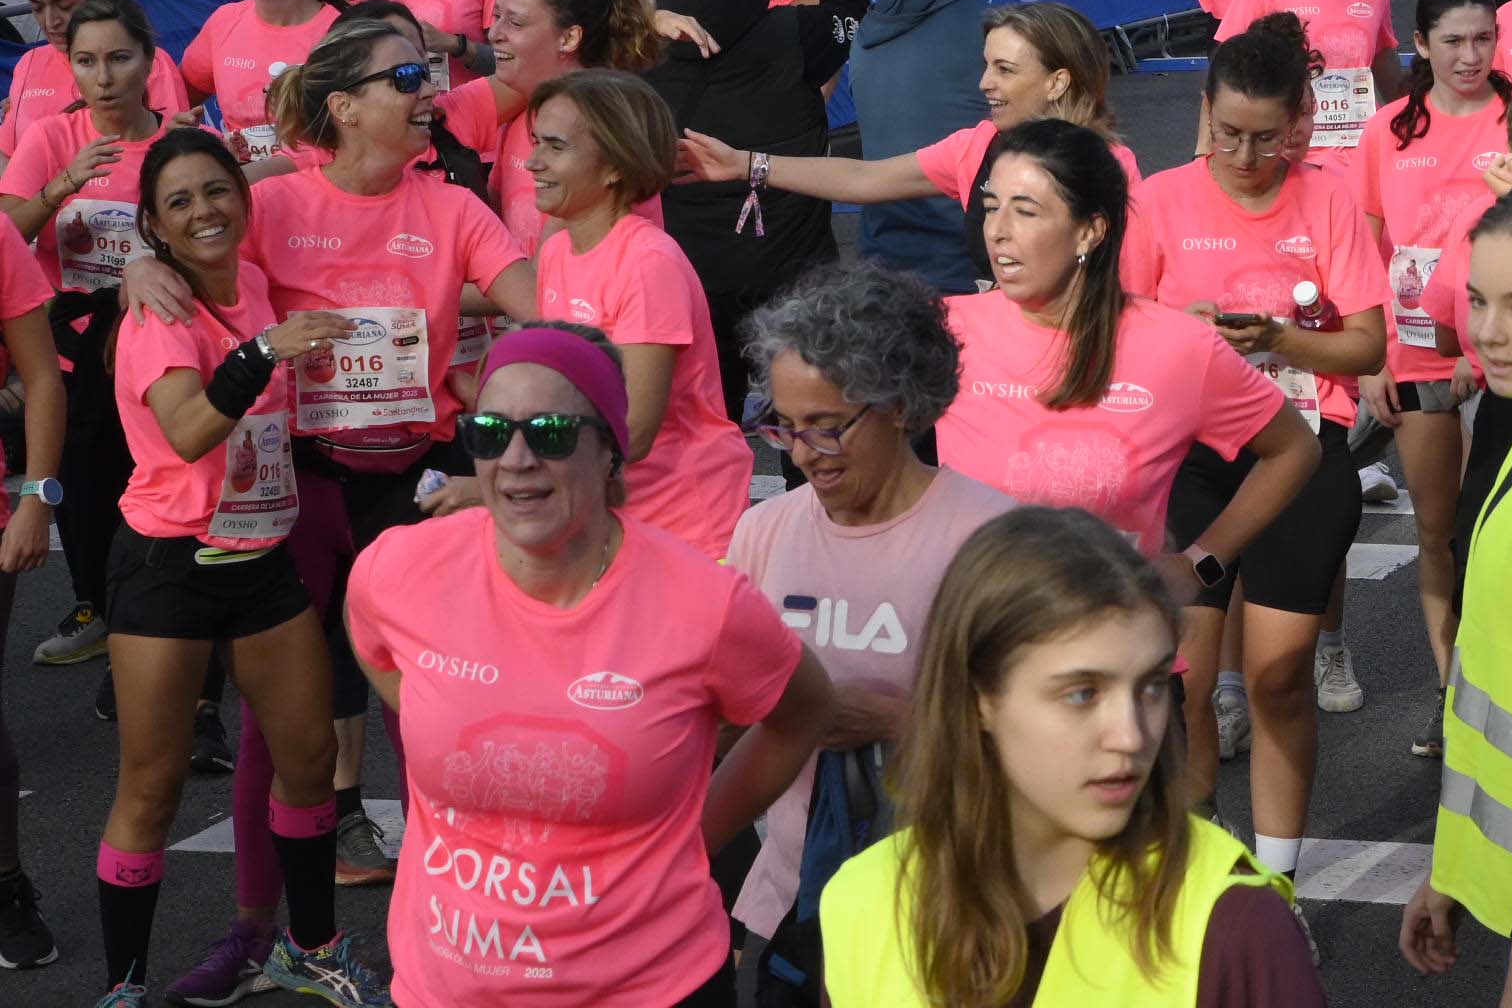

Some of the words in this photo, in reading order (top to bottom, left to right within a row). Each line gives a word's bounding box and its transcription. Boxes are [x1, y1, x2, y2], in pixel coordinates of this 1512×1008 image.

[224, 56, 255, 69] OYSHO
[1320, 99, 1349, 111] 016
[1324, 113, 1347, 121] 14057
[1396, 156, 1437, 170] OYSHO
[96, 236, 132, 254] 016
[287, 235, 342, 251] OYSHO
[390, 242, 430, 254] ASTURIANA
[1182, 238, 1237, 250] OYSHO
[340, 355, 383, 372] 016
[345, 377, 379, 389] 32487
[373, 391, 399, 400] MUJER
[781, 595, 908, 654] FILA
[417, 649, 499, 686] OYSHO
[573, 684, 640, 703] ASTURIANA
[429, 894, 548, 963] SUMA
[524, 966, 553, 979] 2023
